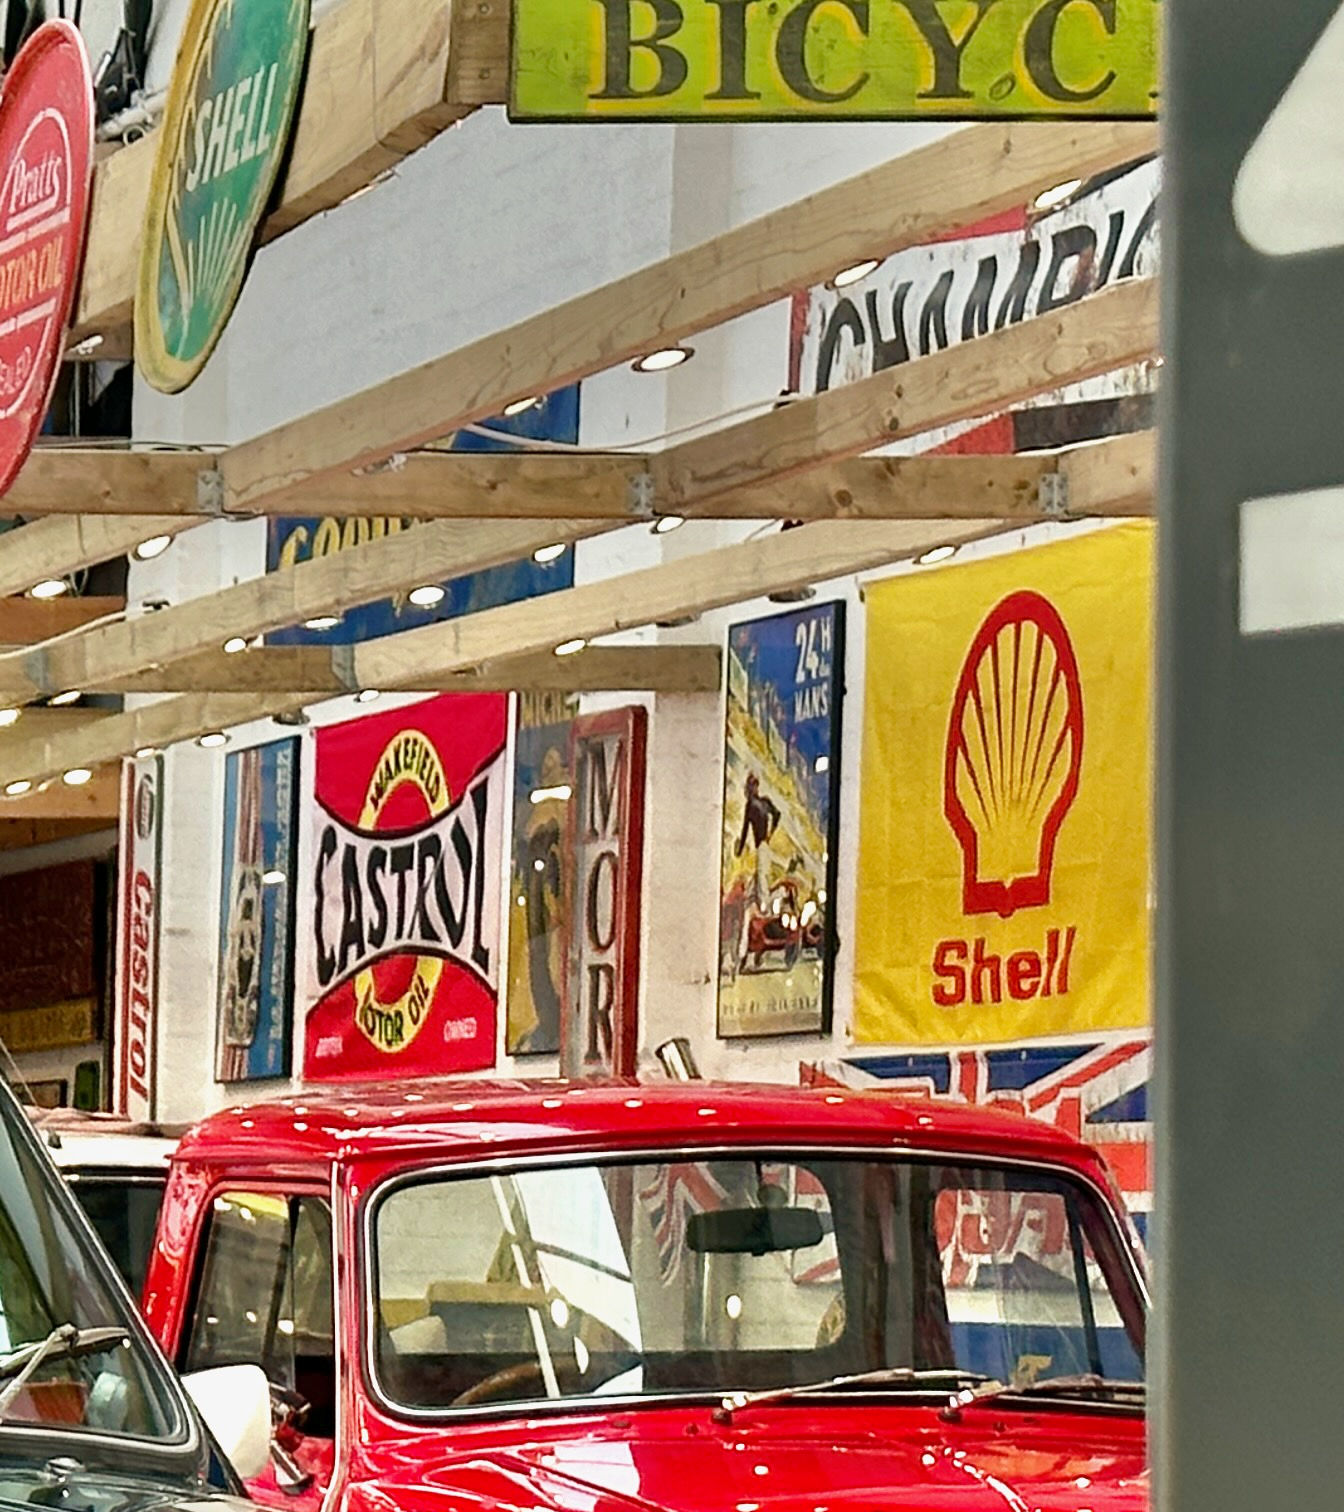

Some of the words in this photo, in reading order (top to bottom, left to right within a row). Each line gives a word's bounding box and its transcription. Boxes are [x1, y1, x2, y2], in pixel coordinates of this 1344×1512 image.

[589, 0, 1160, 102] BICYC
[186, 62, 280, 193] SHELL
[36, 235, 65, 294] OIL
[794, 619, 820, 685] 24
[793, 682, 830, 724] MANS
[371, 736, 442, 812] WAKEFIELD
[314, 777, 490, 988] CASTROL
[129, 868, 155, 1104] Castrol
[408, 974, 430, 1026] OIL
[930, 925, 1078, 1010] Shell
